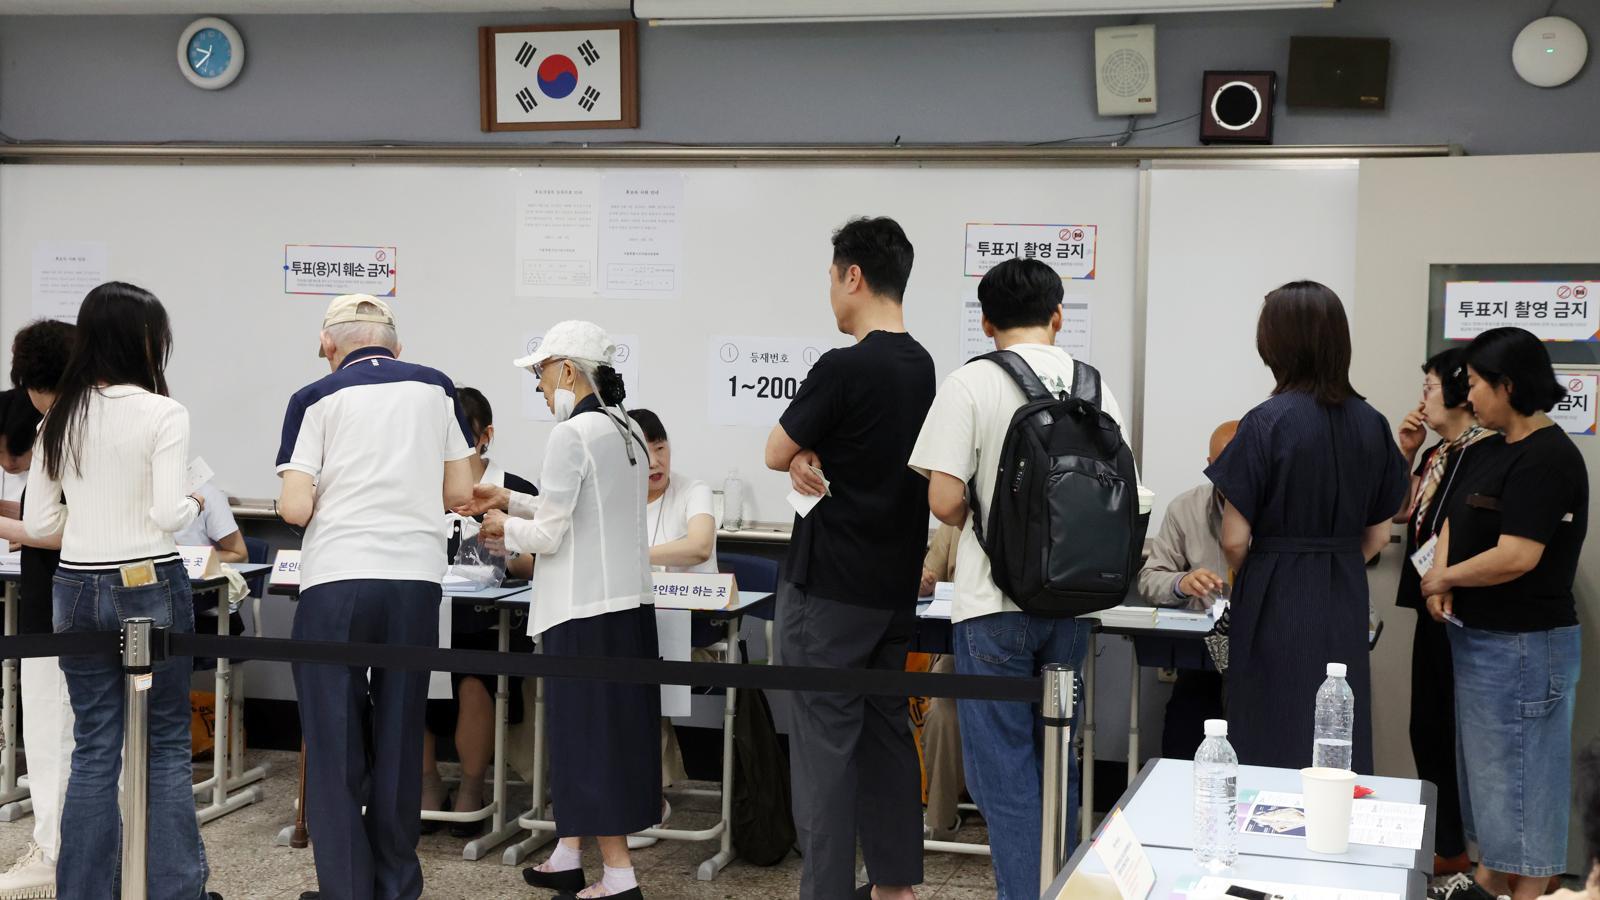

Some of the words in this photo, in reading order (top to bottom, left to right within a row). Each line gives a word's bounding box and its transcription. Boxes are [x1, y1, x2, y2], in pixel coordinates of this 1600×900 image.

[977, 241, 1018, 257] 투표지
[1023, 242, 1052, 258] 촬영
[1056, 243, 1084, 259] 금지
[291, 261, 340, 277] 투표(용)지
[343, 262, 366, 277] 훼손
[367, 263, 389, 278] 금지
[1458, 301, 1508, 318] 투표지
[1514, 301, 1548, 318] 촬영
[1553, 301, 1587, 318] 금지
[749, 352, 789, 363] 등재번호
[728, 375, 797, 399] 1~200
[1557, 394, 1587, 411] 금지
[193, 556, 203, 567] 곳
[692, 586, 713, 597] 하는
[716, 586, 726, 597] 곳
